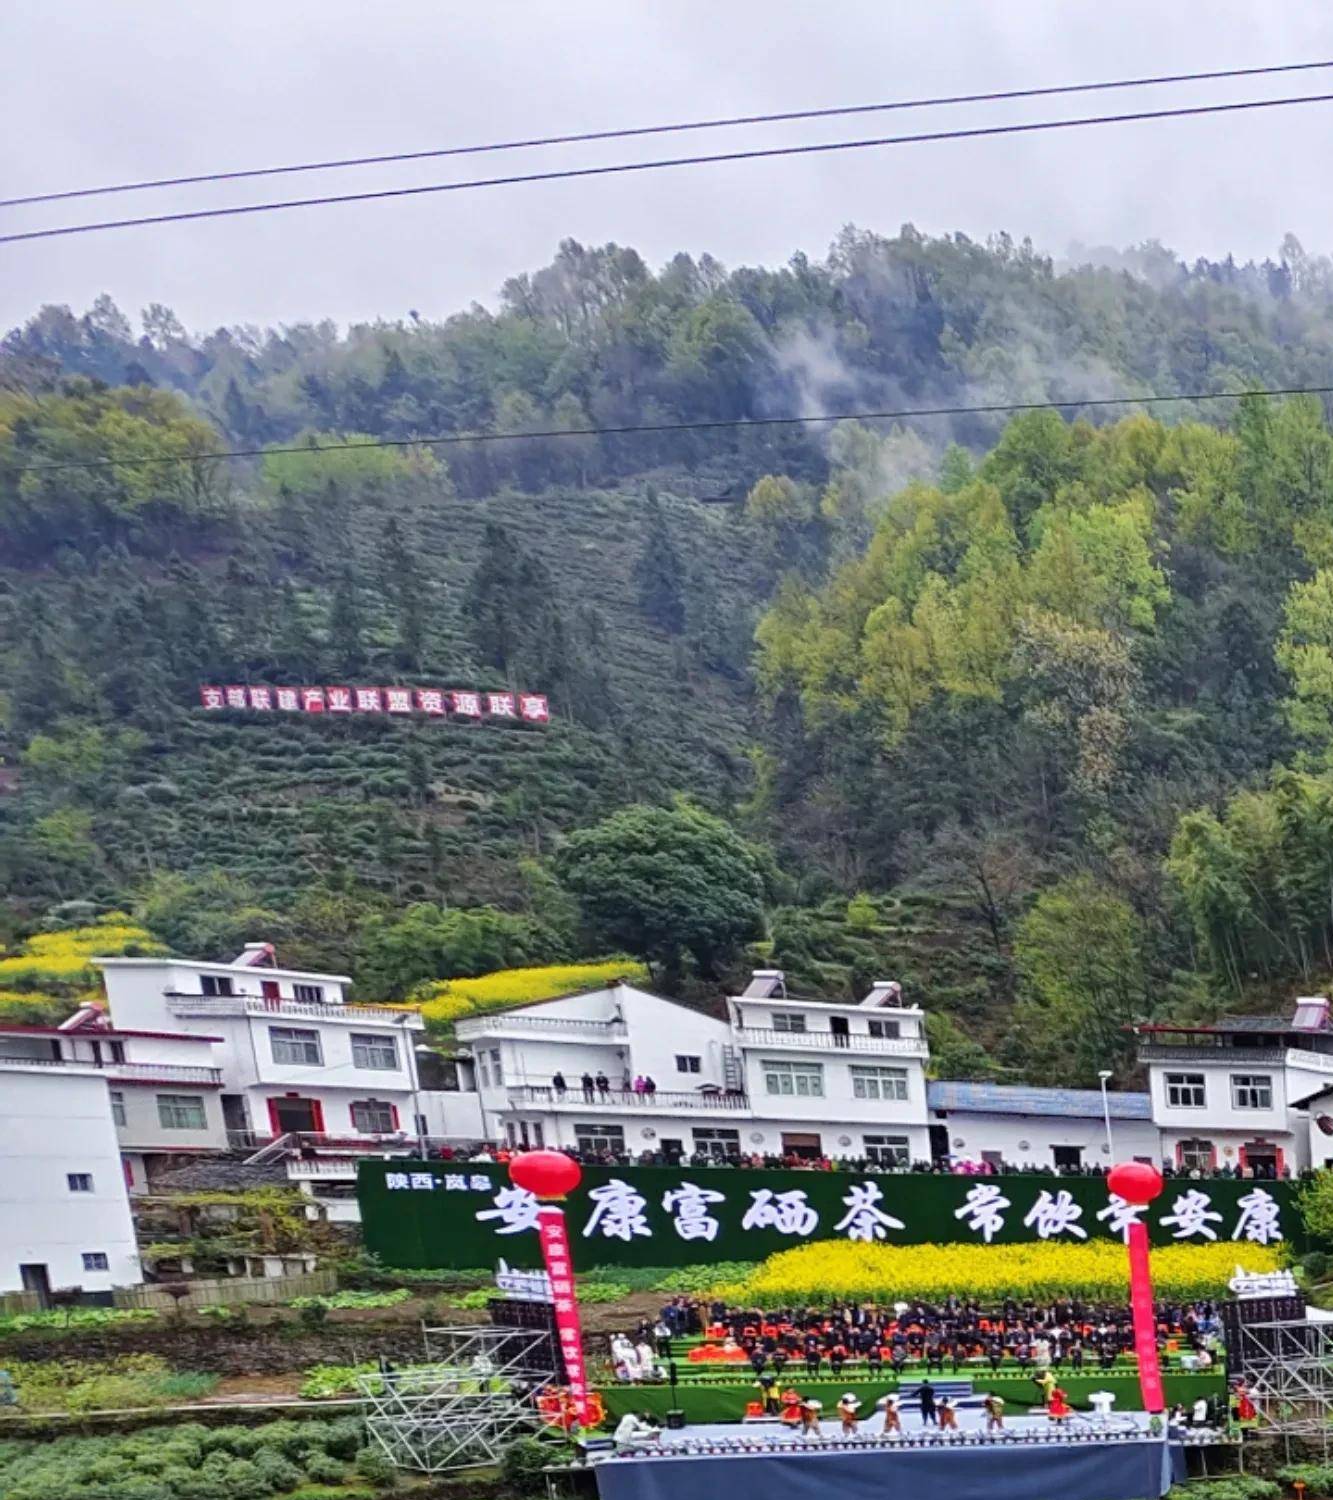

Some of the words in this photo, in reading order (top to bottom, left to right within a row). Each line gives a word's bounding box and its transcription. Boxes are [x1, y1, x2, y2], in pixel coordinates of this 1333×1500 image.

[385, 1172, 492, 1191] 陕西·岚皋
[475, 1179, 905, 1242] 安康富硒茶
